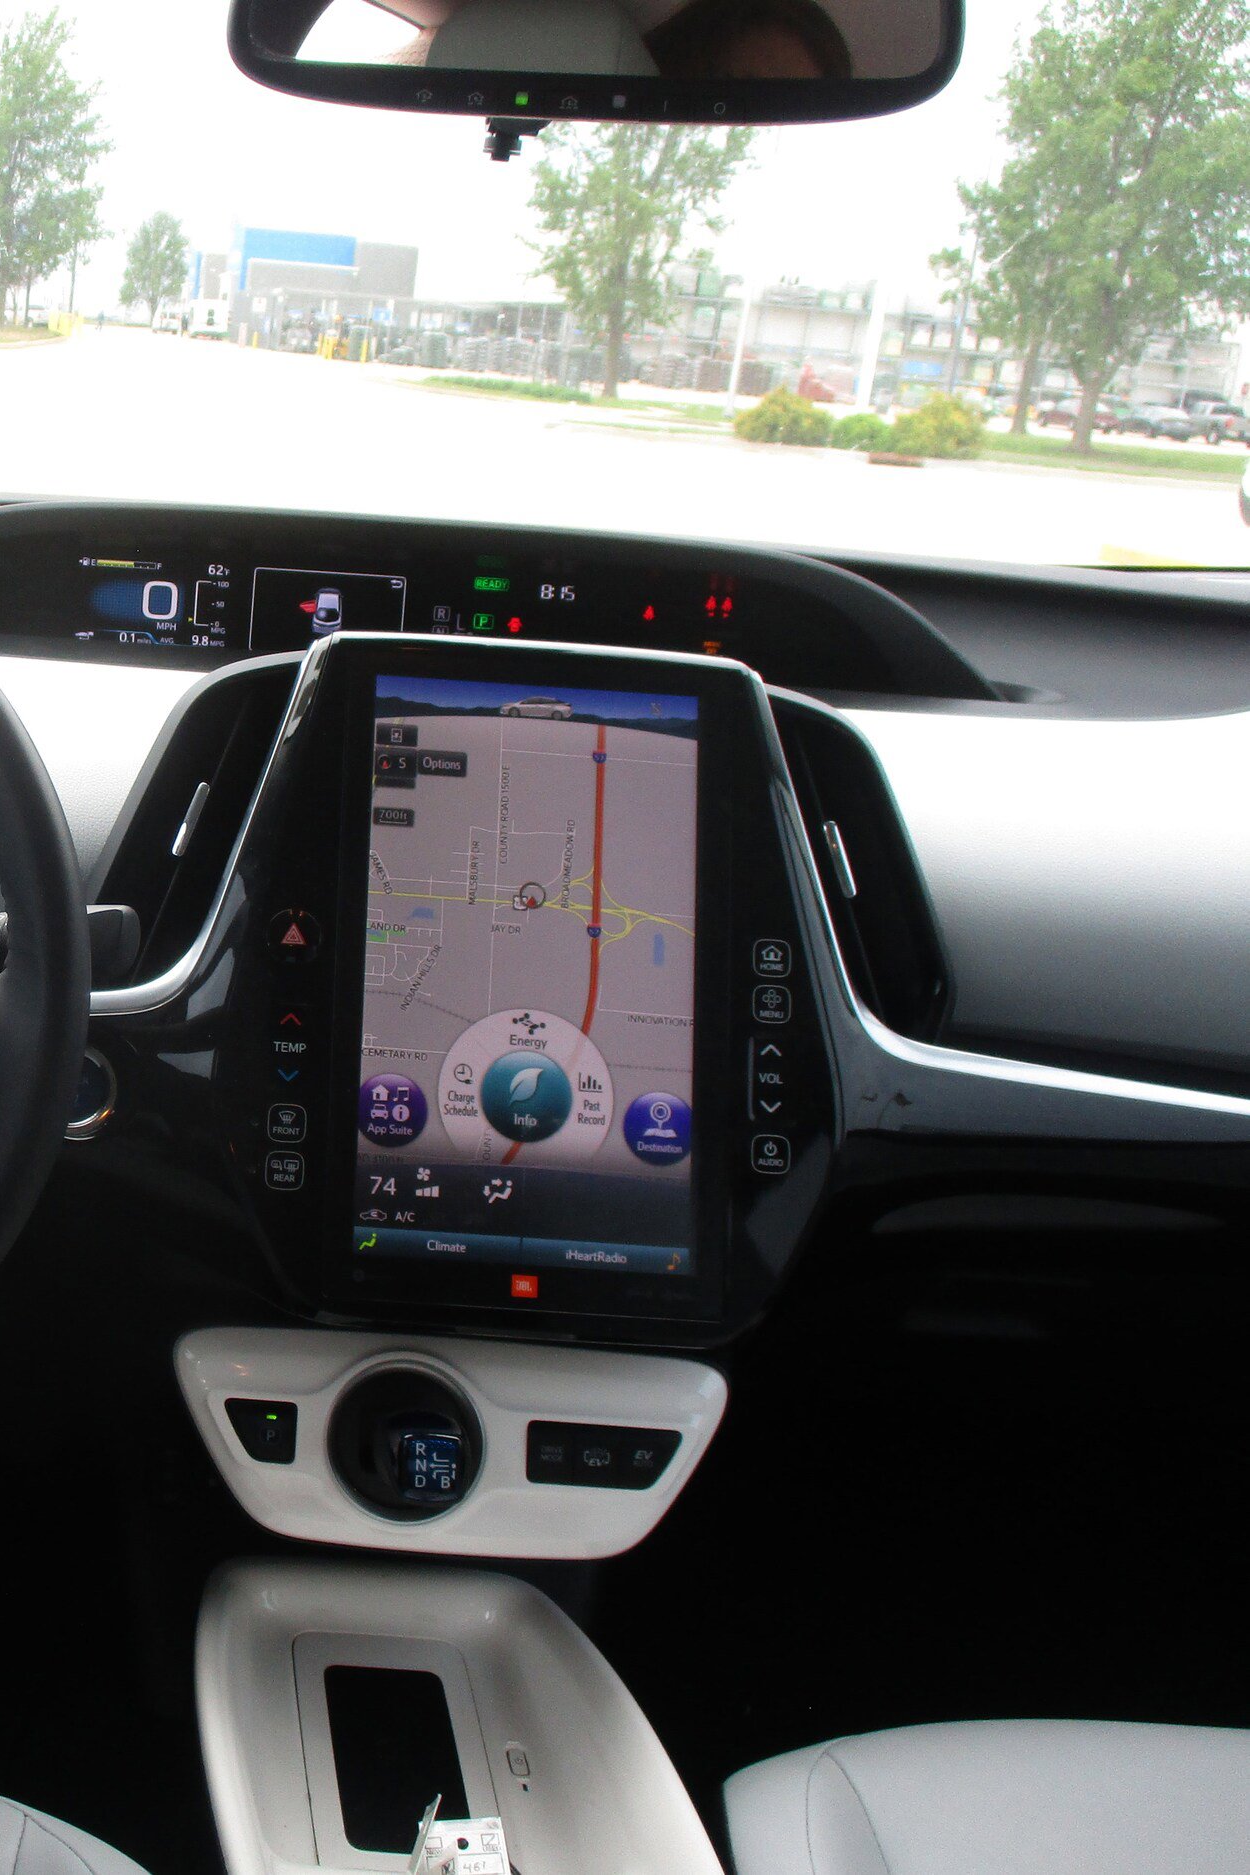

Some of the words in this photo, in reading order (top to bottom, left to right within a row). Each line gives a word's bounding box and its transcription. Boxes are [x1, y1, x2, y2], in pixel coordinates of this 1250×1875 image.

[476, 578, 508, 590] READY
[540, 584, 575, 601] 8:15
[142, 580, 178, 620] 0
[156, 622, 177, 631] MPH
[119, 632, 136, 643] 0.1
[160, 637, 174, 645] AVG
[191, 635, 209, 646] 9.8
[398, 757, 407, 769] S
[422, 756, 461, 771] Options
[380, 809, 408, 820] 700ft
[501, 796, 510, 822] ROAD
[566, 819, 576, 834] RD
[500, 824, 508, 865] COUNTY
[561, 834, 575, 909] BROADMEADOW
[468, 852, 479, 906] MALSBURY
[490, 924, 506, 934] JAY
[508, 925, 521, 934] DR
[400, 979, 421, 1012] INDIAN
[418, 957, 435, 981] HILLS
[433, 943, 443, 957] DR
[759, 1010, 784, 1019] MENU
[627, 1015, 687, 1028] INNOVATION
[273, 1041, 307, 1054] TEMP
[509, 1034, 548, 1050] Energy
[362, 1047, 413, 1060] CEMETARY
[414, 1052, 428, 1061] RD
[759, 1072, 783, 1084] VOL
[447, 1090, 475, 1105] Charge
[443, 1103, 479, 1117] Schedule
[583, 1099, 600, 1111] Past
[514, 1113, 538, 1127] Info
[577, 1113, 606, 1125] Record
[272, 1126, 300, 1136] FRONT
[367, 1122, 387, 1136] App
[388, 1124, 413, 1136] Suite
[637, 1140, 683, 1154] Destination
[757, 1158, 784, 1167] AUDIO
[273, 1173, 295, 1183] REAR
[370, 1175, 397, 1196] 74
[395, 1211, 416, 1223] A/C
[427, 1239, 467, 1253] Climate
[565, 1250, 628, 1264] iHeartRadio
[266, 1428, 275, 1441] P
[415, 1442, 427, 1456] R
[635, 1450, 653, 1460] EV
[415, 1459, 428, 1472] N
[414, 1475, 426, 1488] D
[440, 1476, 451, 1489] B
